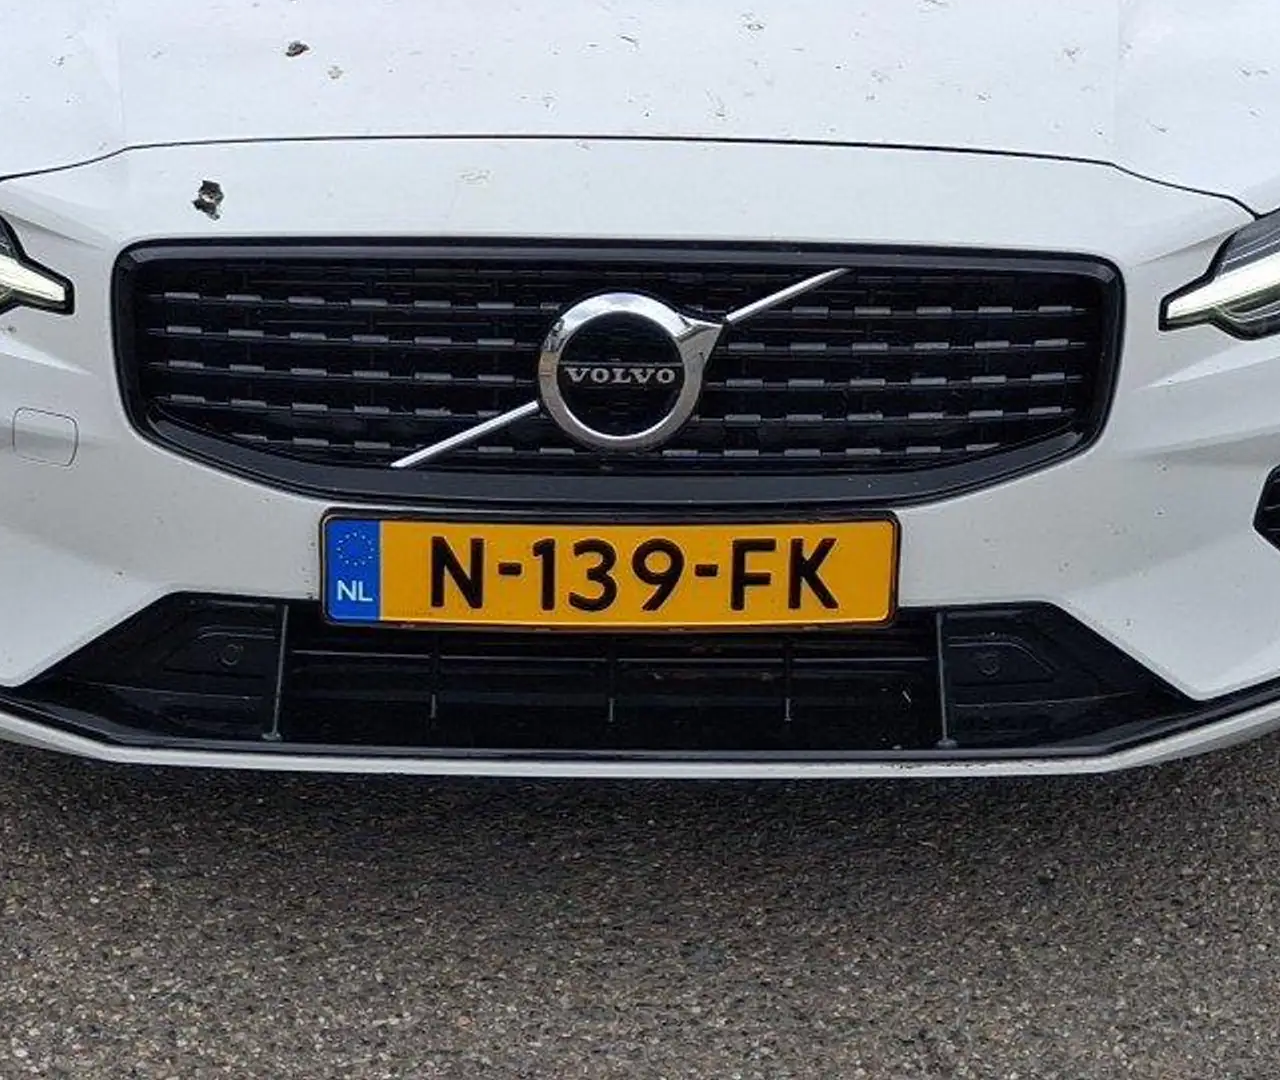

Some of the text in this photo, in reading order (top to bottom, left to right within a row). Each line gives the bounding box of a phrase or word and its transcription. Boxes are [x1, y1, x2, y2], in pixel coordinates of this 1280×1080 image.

[564, 367, 676, 384] VOLVO
[430, 536, 839, 612] N-139-FK
[336, 580, 373, 602] NL
